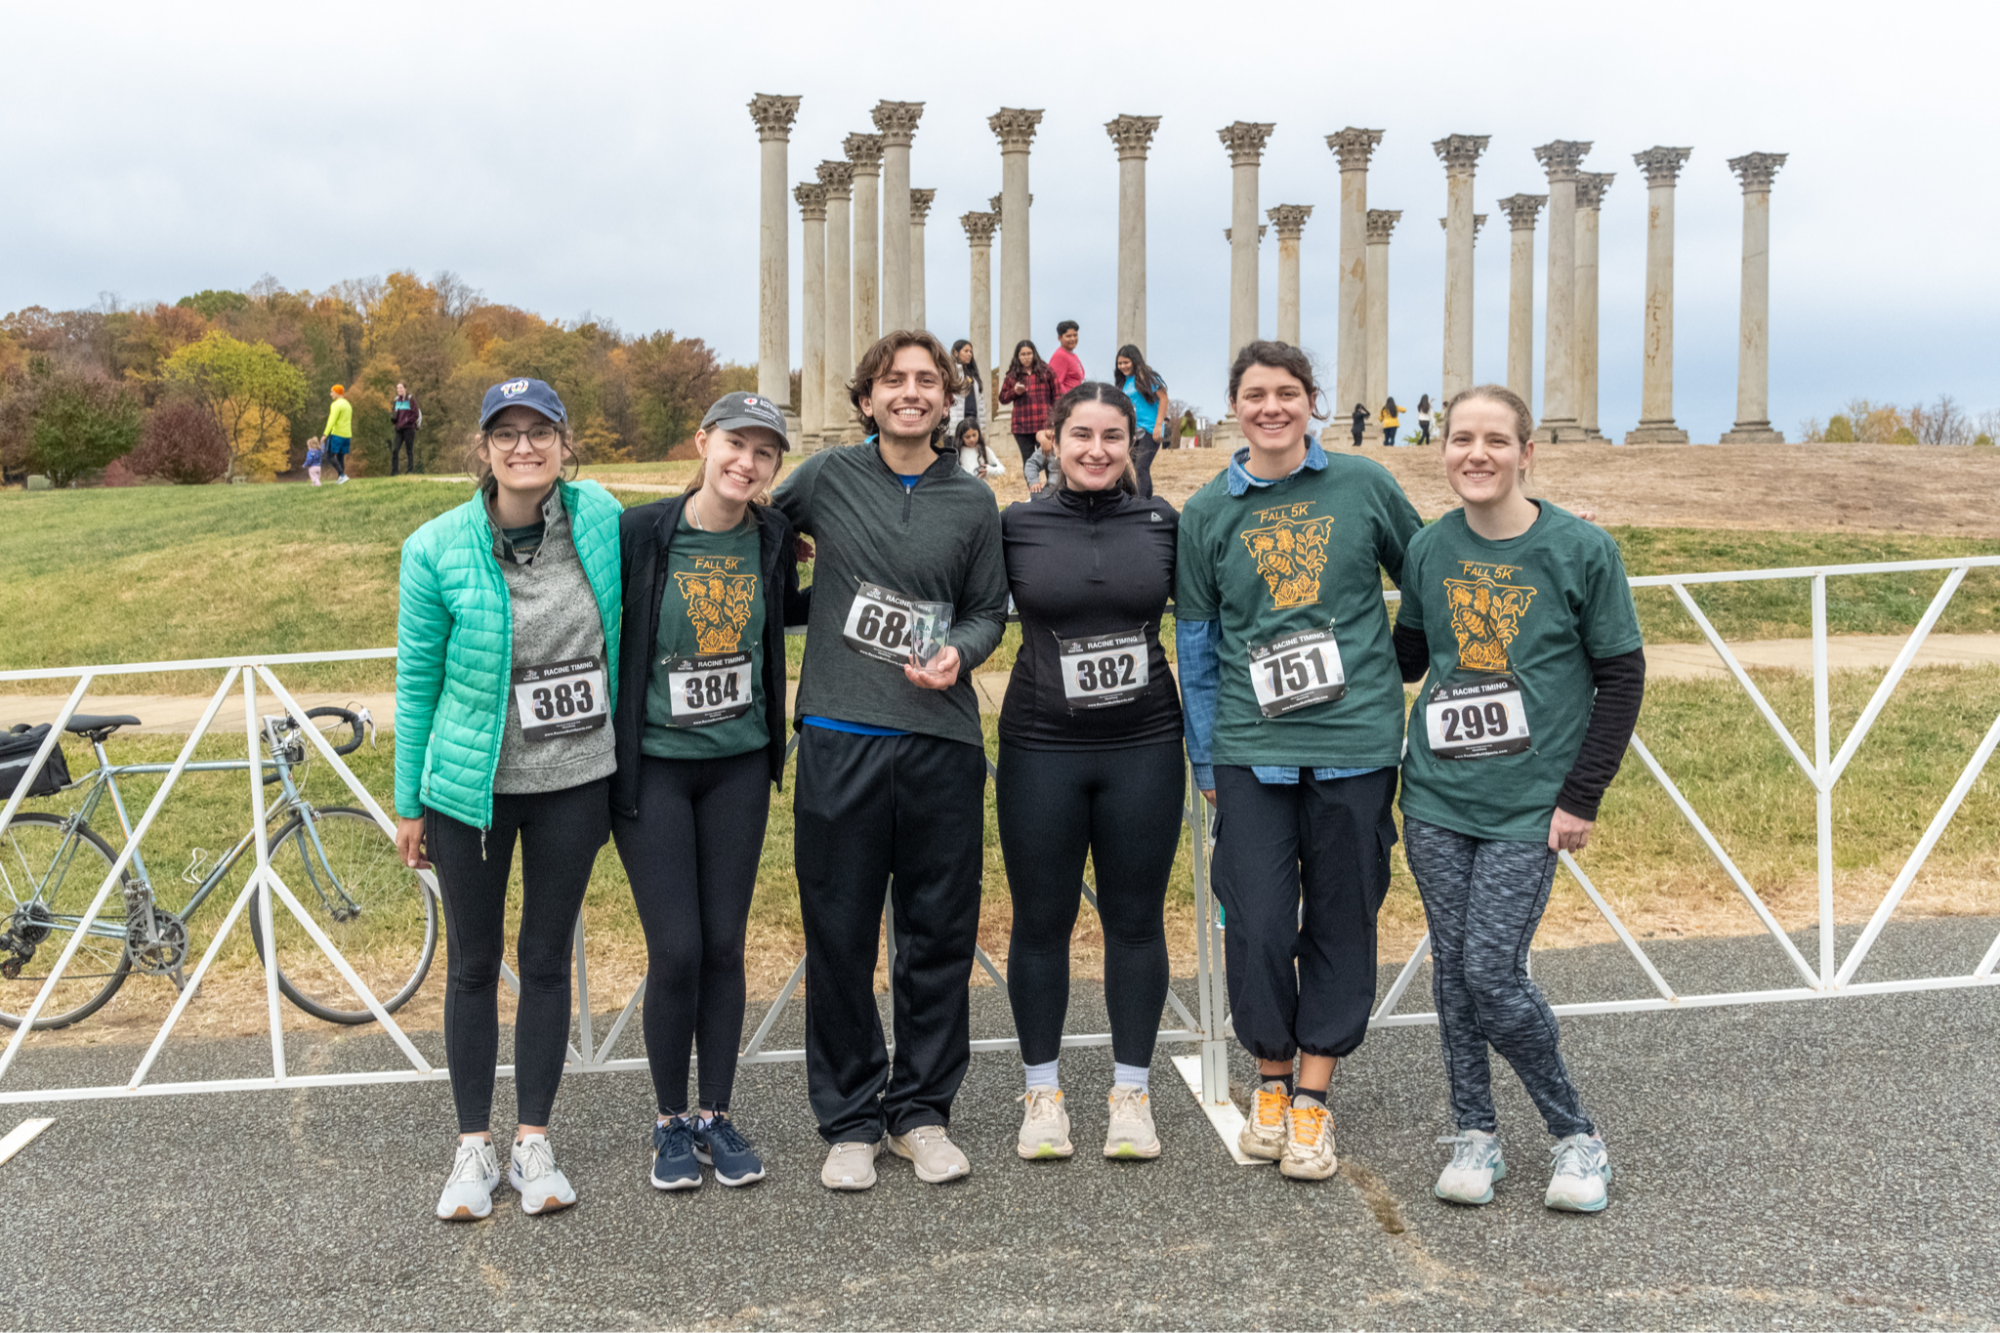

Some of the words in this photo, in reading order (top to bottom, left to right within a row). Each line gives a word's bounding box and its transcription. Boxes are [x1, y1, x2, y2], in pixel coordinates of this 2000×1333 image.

[1260, 510, 1287, 523] FALL
[1291, 505, 1308, 518] 5K
[695, 559, 721, 569] FALL
[724, 559, 739, 570] 5K
[1463, 564, 1490, 577] FALL
[1493, 567, 1514, 580] 5K
[885, 594, 911, 607] RACINE
[1087, 640, 1114, 650] RACINE
[1114, 635, 1138, 645] TIMING
[1272, 638, 1298, 651] RACINE
[1299, 632, 1325, 643] TIMING
[543, 665, 570, 677] RACINE
[570, 661, 594, 672] TIMING
[697, 659, 724, 668] RACINE
[724, 655, 746, 665] TIMING
[1077, 653, 1137, 692] 382
[1263, 647, 1328, 698] 751
[685, 672, 740, 710] 384
[1452, 686, 1481, 697] RACINE
[1481, 681, 1509, 692] TIMING
[532, 679, 594, 721] 383
[1441, 701, 1509, 742] 299
